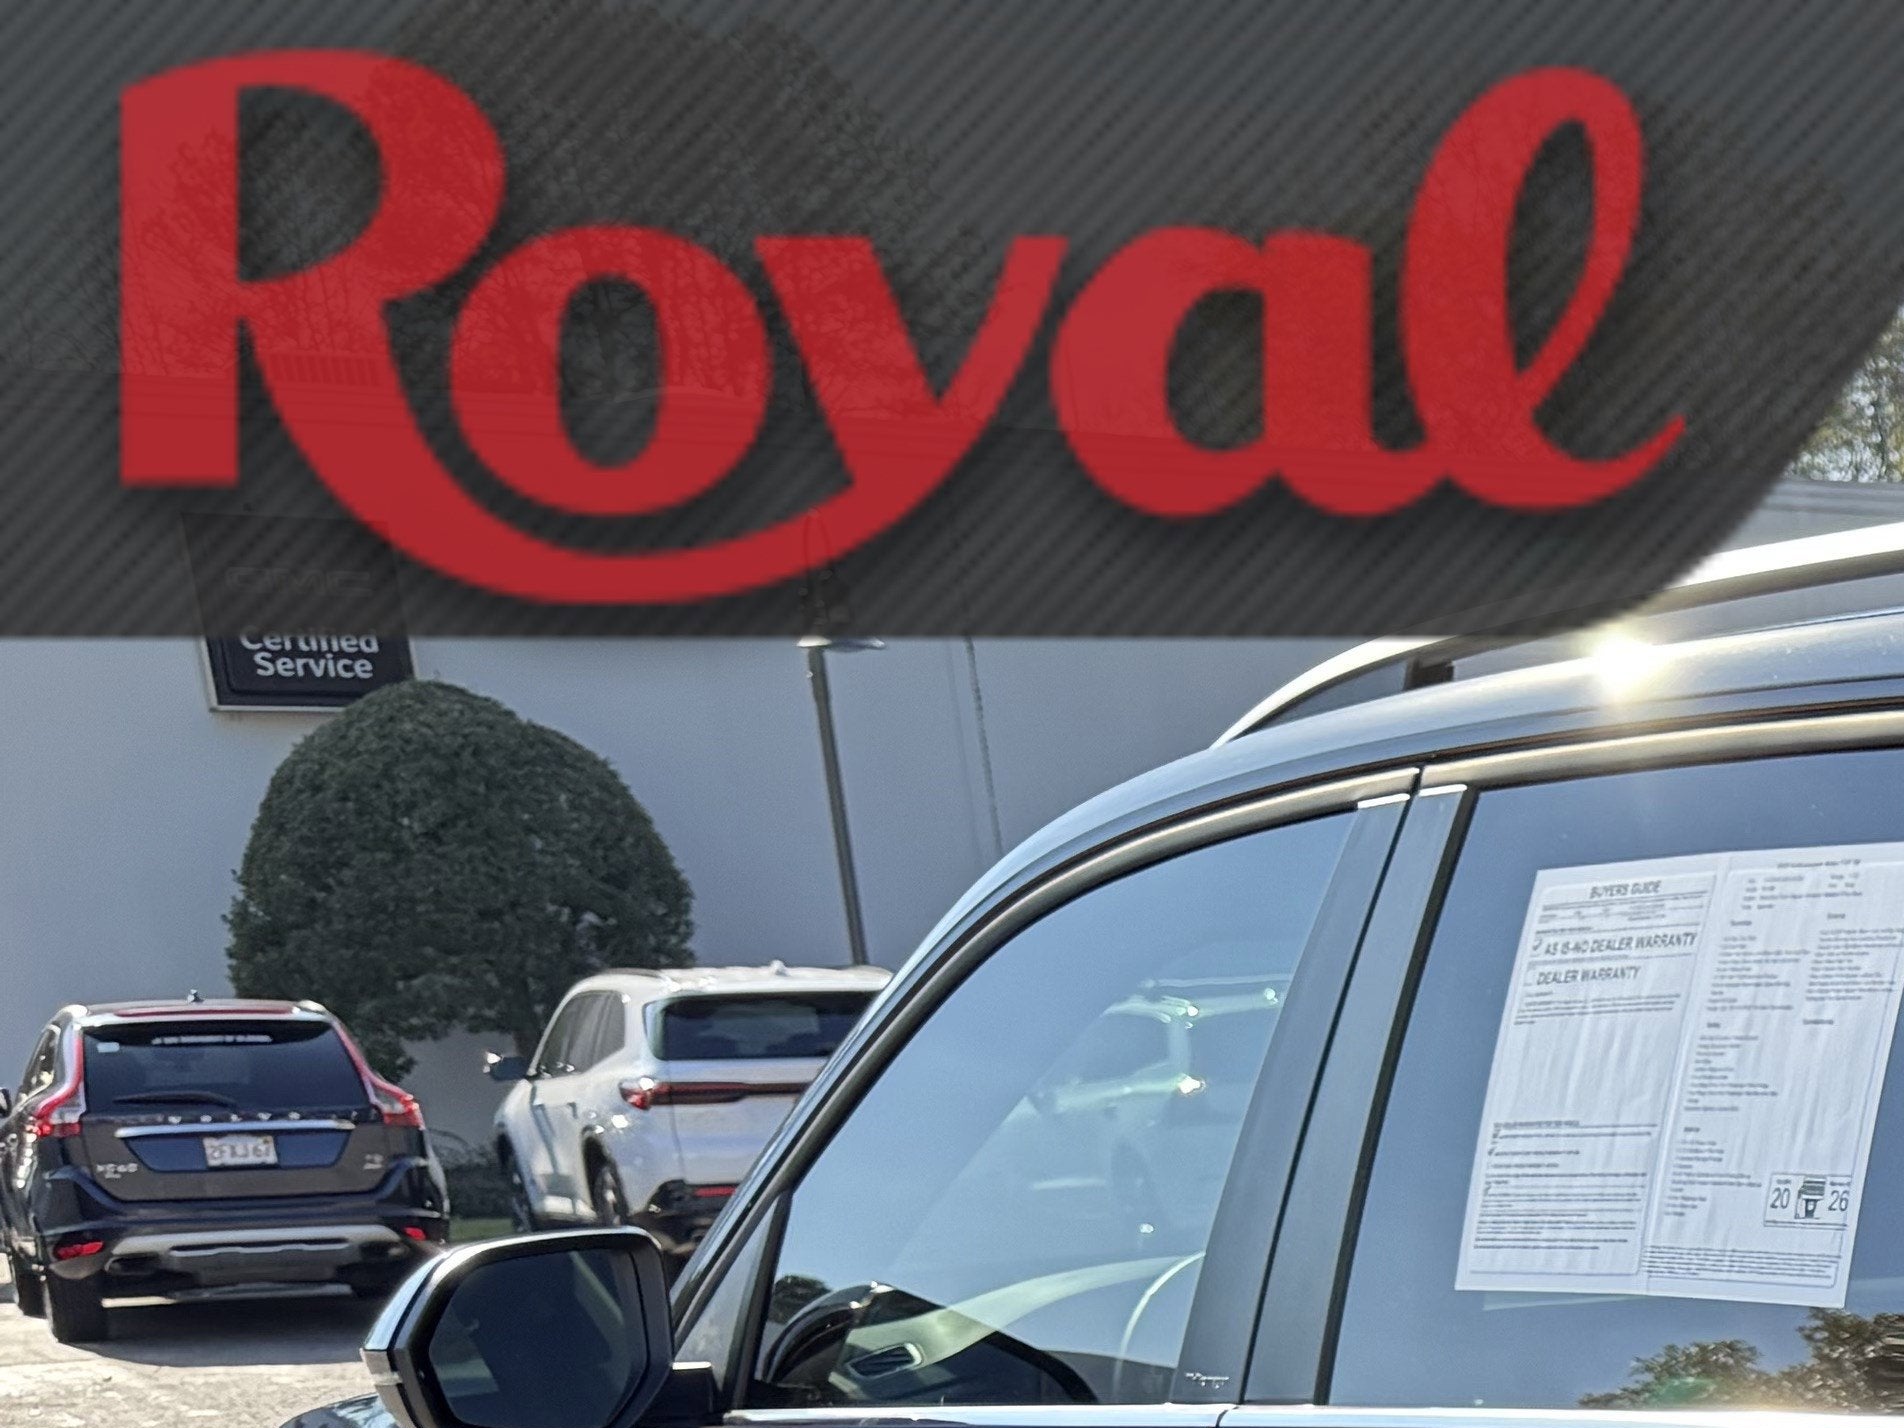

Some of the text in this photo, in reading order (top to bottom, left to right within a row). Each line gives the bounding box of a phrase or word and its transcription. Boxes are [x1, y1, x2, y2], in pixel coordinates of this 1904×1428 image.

[239, 627, 379, 653] Certified
[254, 651, 374, 679] Service
[1590, 937, 1634, 954] DEALER
[1536, 969, 1579, 986] DEALER
[1770, 1187, 1851, 1211] 20 26
